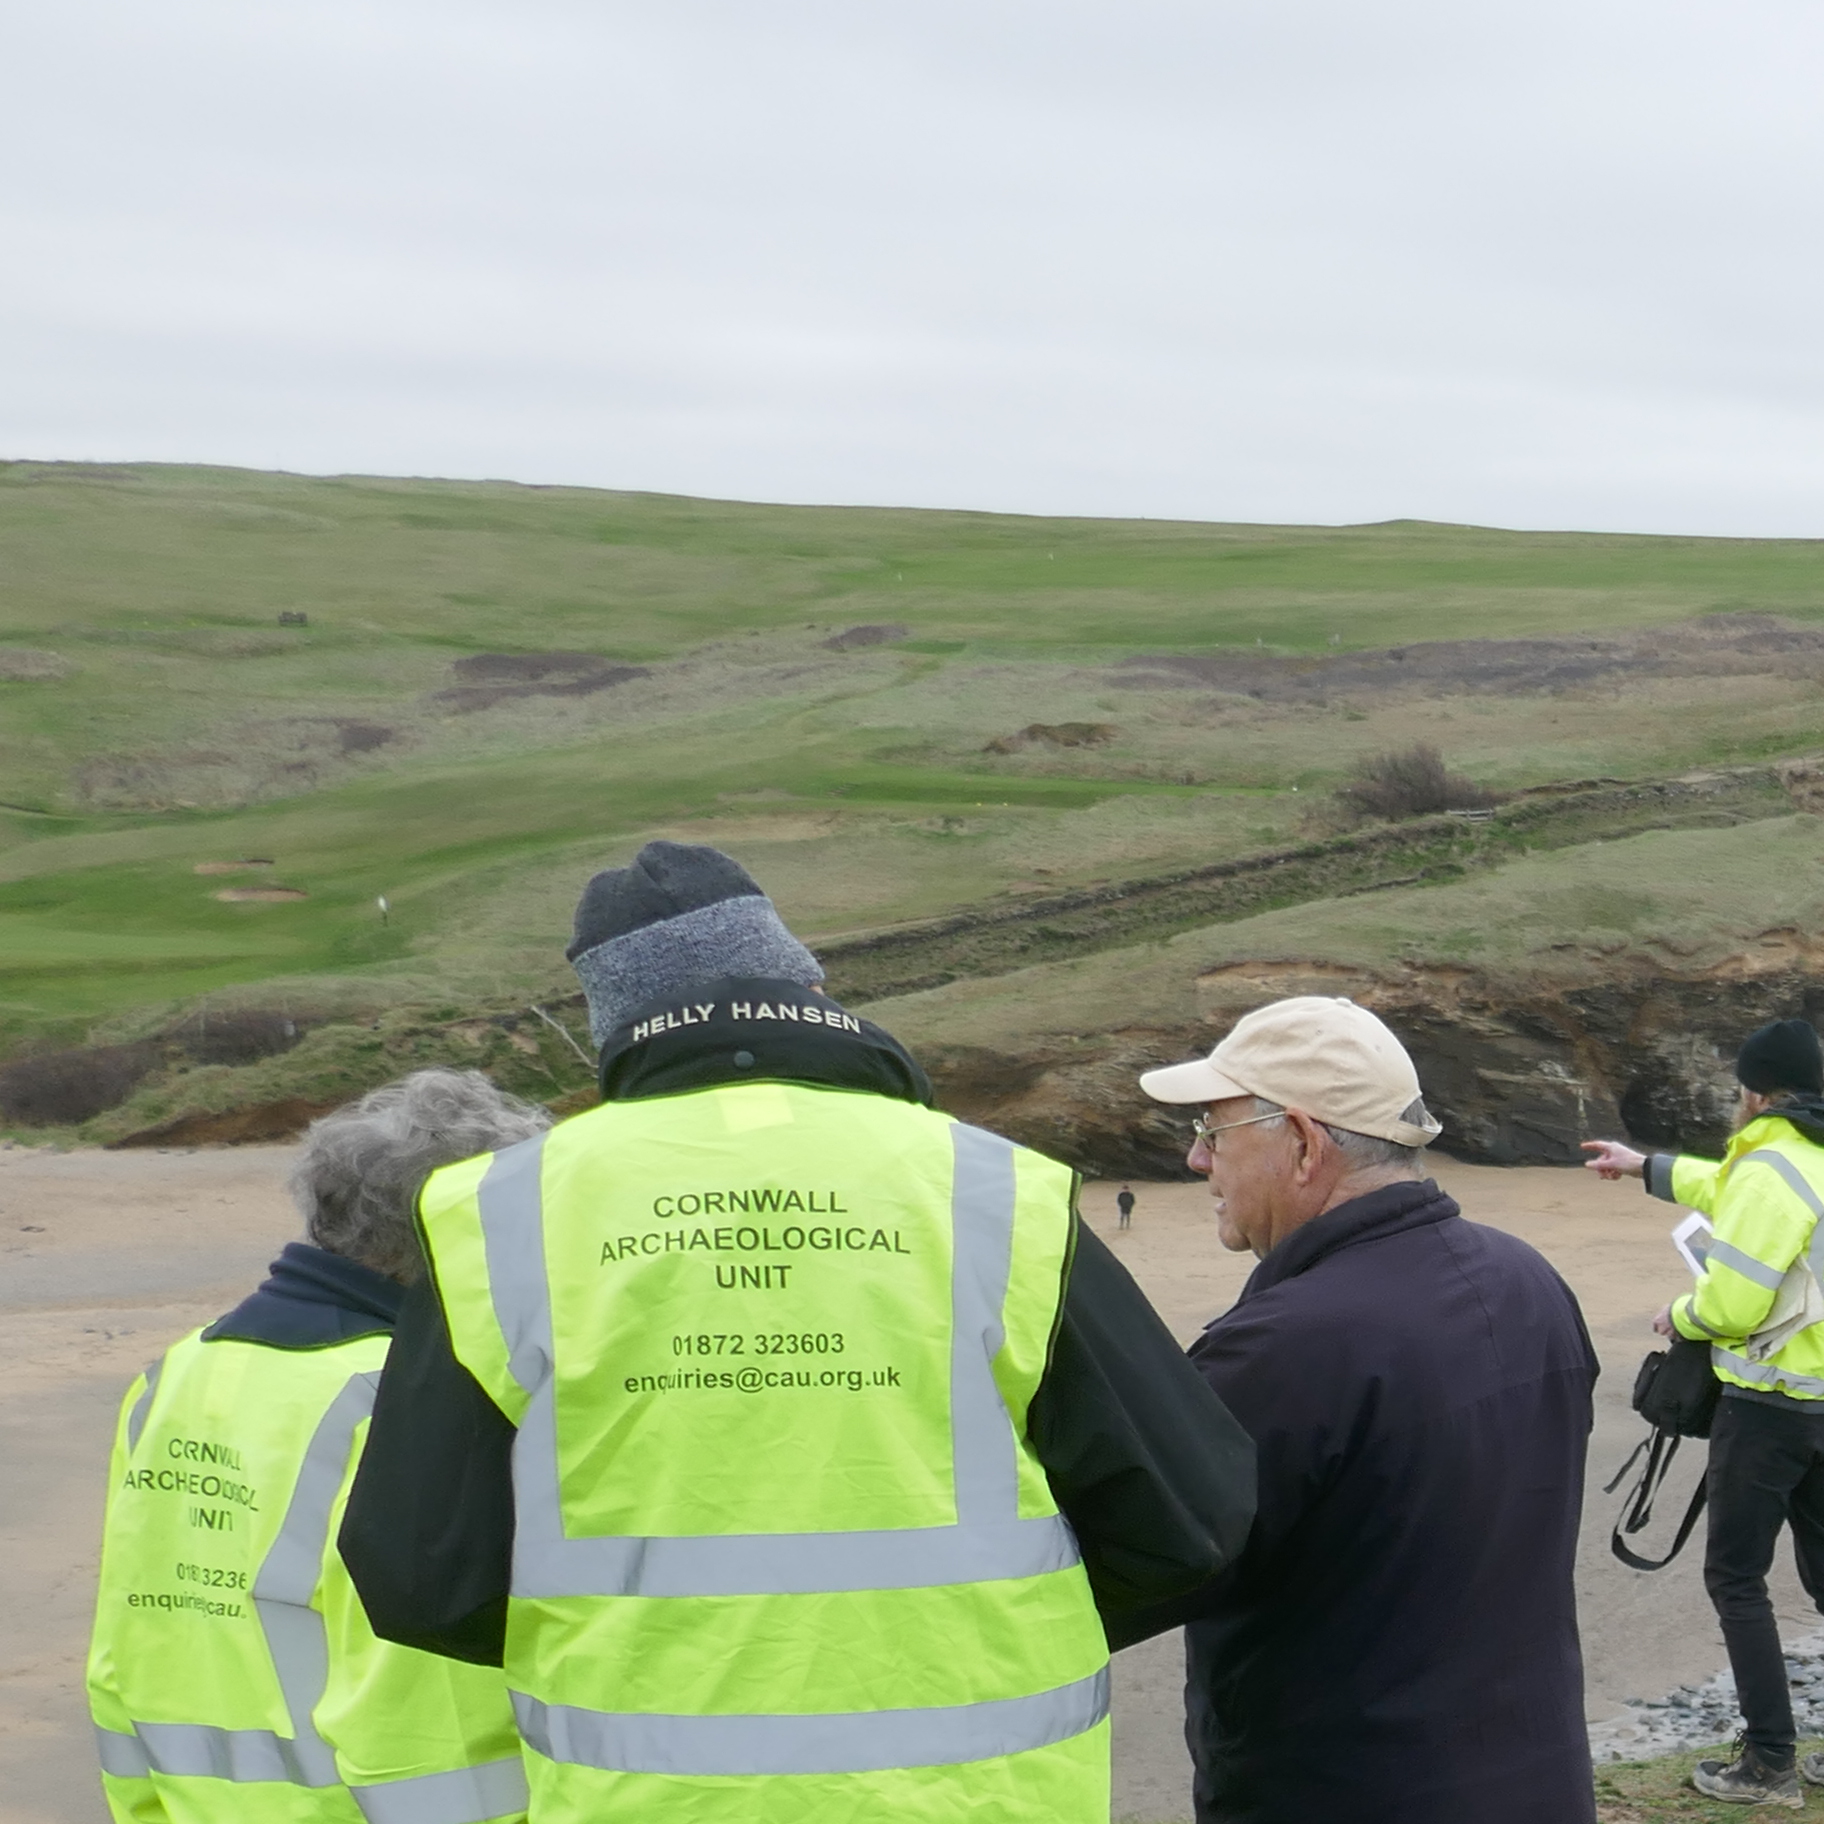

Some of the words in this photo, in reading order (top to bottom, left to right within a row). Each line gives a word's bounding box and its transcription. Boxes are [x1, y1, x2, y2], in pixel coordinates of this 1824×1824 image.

[633, 1003, 716, 1042] HELLY
[731, 1002, 862, 1034] HANSEN
[653, 1189, 848, 1218] CORNWALL
[600, 1226, 911, 1266] ARCHAEOLOGICAL
[715, 1265, 792, 1290] UNIT
[672, 1334, 745, 1356] 01872
[754, 1333, 845, 1354] 323603
[624, 1366, 901, 1395] enquiries@cau.org.uk
